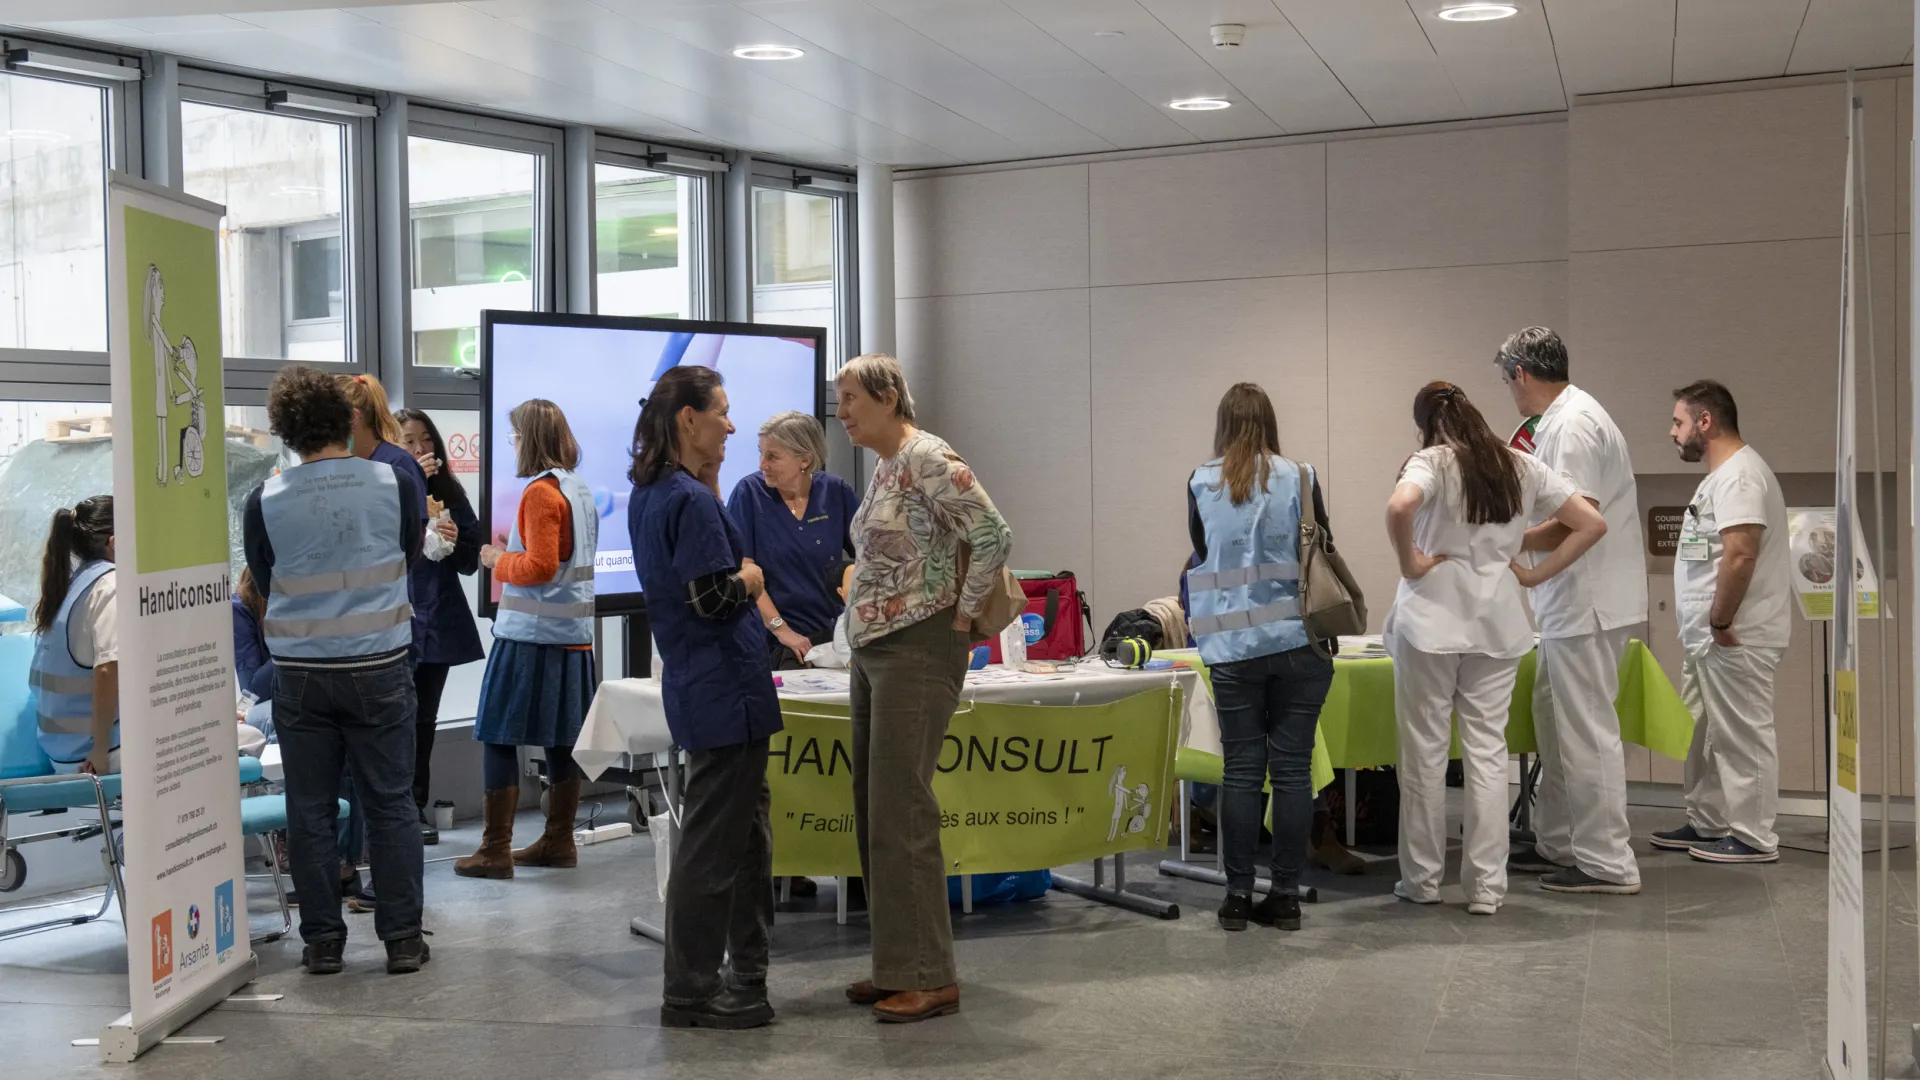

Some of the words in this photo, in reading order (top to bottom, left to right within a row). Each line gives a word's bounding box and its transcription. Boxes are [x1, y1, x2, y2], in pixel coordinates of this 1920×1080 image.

[1658, 523, 1683, 531] INTERN
[606, 553, 633, 568] quand
[139, 574, 231, 617] Handiconsult
[768, 735, 1113, 777] HANONSULT
[800, 813, 855, 833] Facili
[965, 810, 1000, 827] aux
[1006, 806, 1058, 825] soins
[1064, 807, 1070, 824] !
[179, 937, 211, 972] Arsanté
